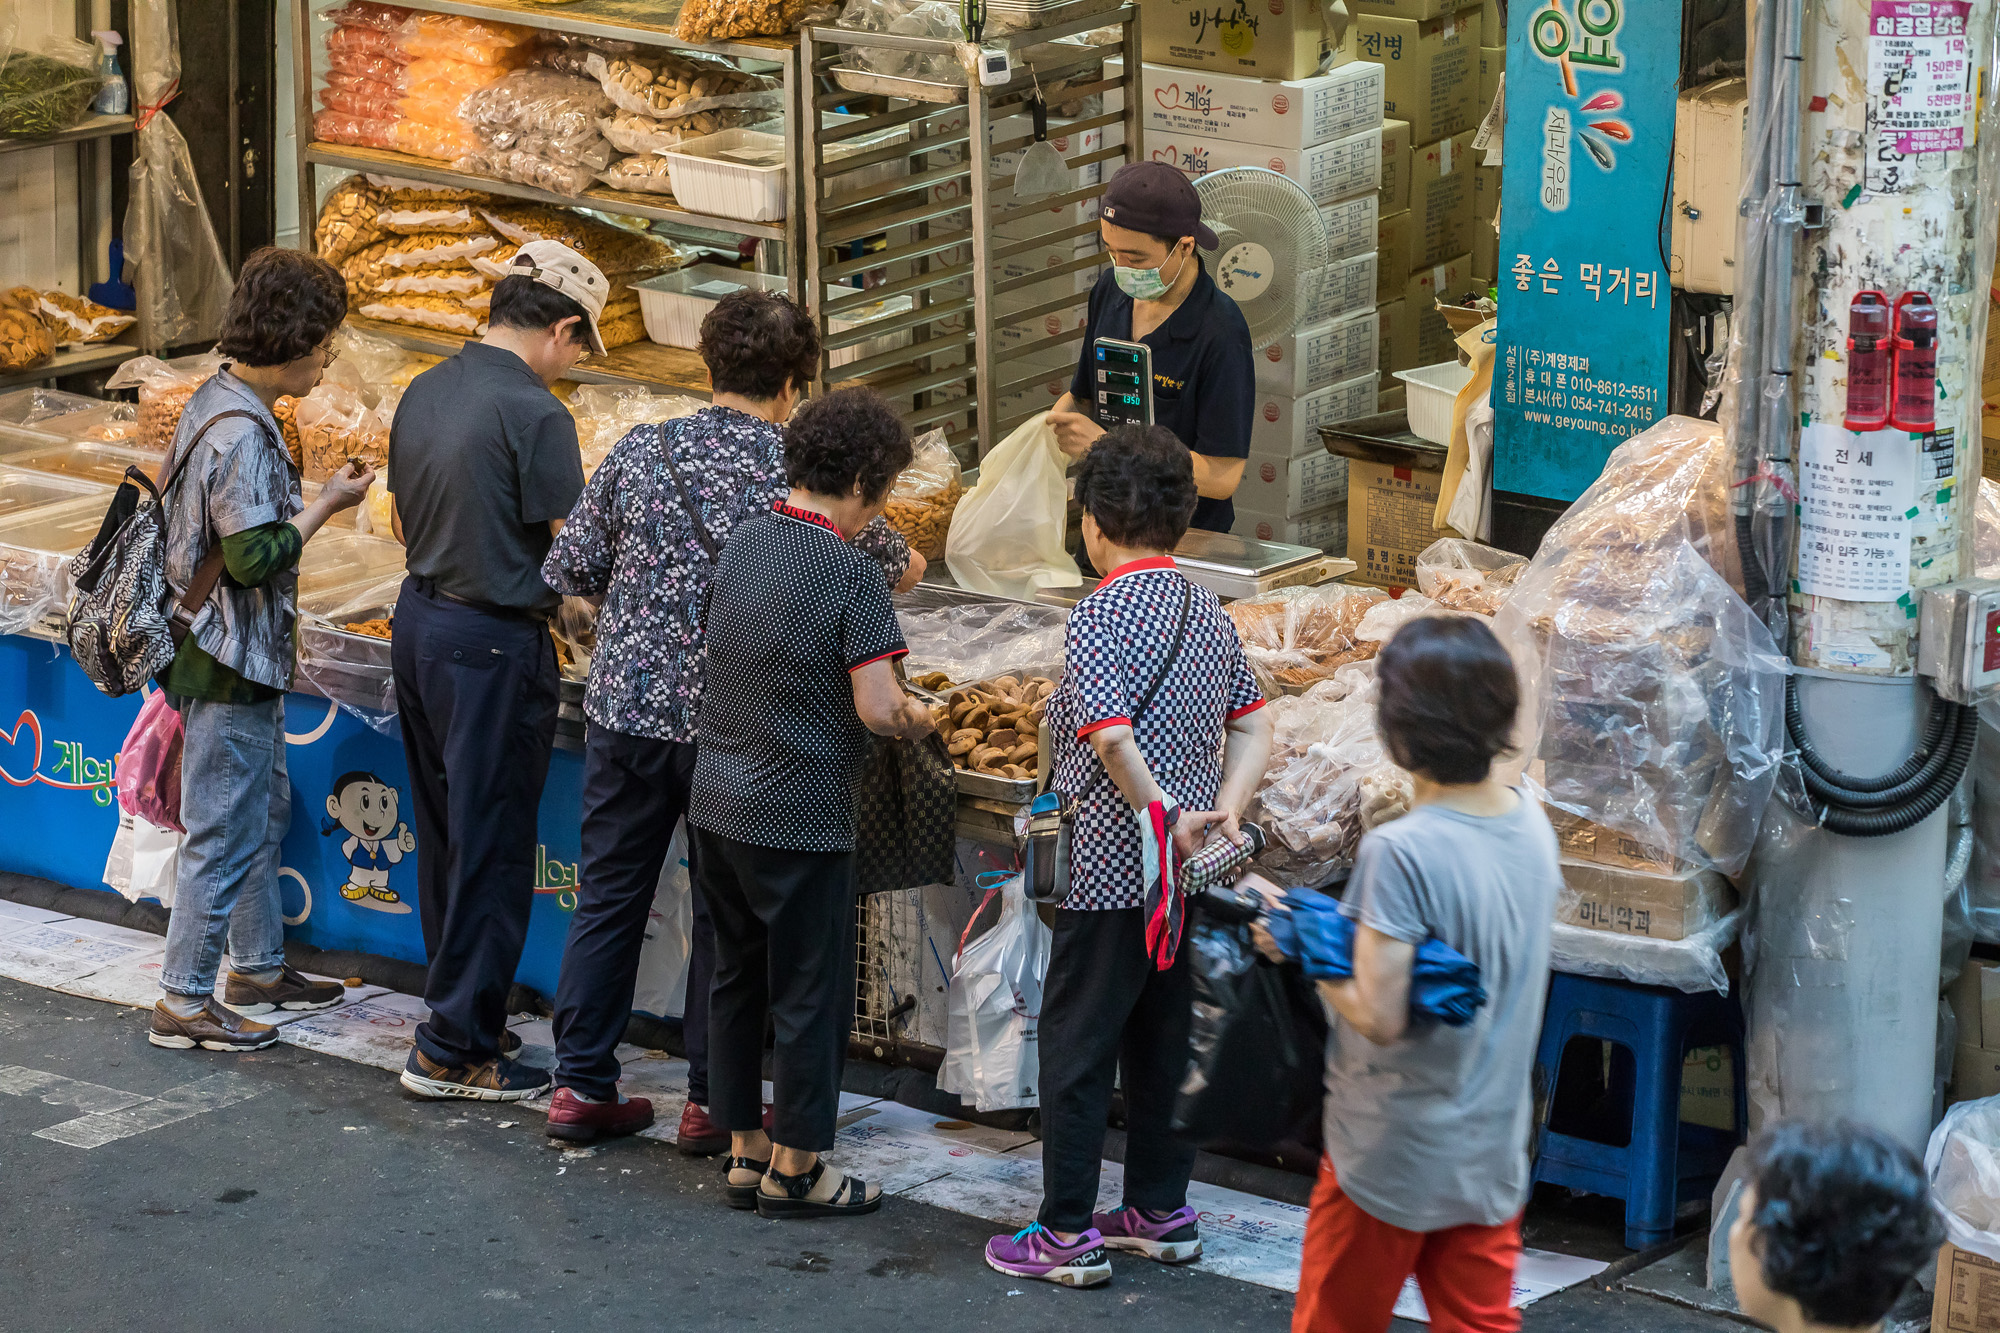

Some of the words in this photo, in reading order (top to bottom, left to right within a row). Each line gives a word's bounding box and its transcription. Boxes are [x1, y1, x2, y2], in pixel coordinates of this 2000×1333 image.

[1945, 39, 1964, 55] 1억
[1185, 91, 1211, 116] 계영
[1511, 253, 1563, 295] 좋은
[1580, 263, 1657, 309] 먹거리
[1133, 354, 1139, 362] 0
[1525, 348, 1590, 373] (주)계영제과
[1134, 376, 1139, 384] 0
[1571, 376, 1657, 402] 010-8612-5511
[1571, 395, 1652, 421] 054-741-2415
[1524, 410, 1643, 437] www.geyoung.co.kr
[1815, 541, 1834, 555] 즉시
[1838, 545, 1859, 558] 입주
[1864, 548, 1885, 560] 가능
[52, 740, 113, 807] 계영
[1580, 901, 1650, 935] 미니약과
